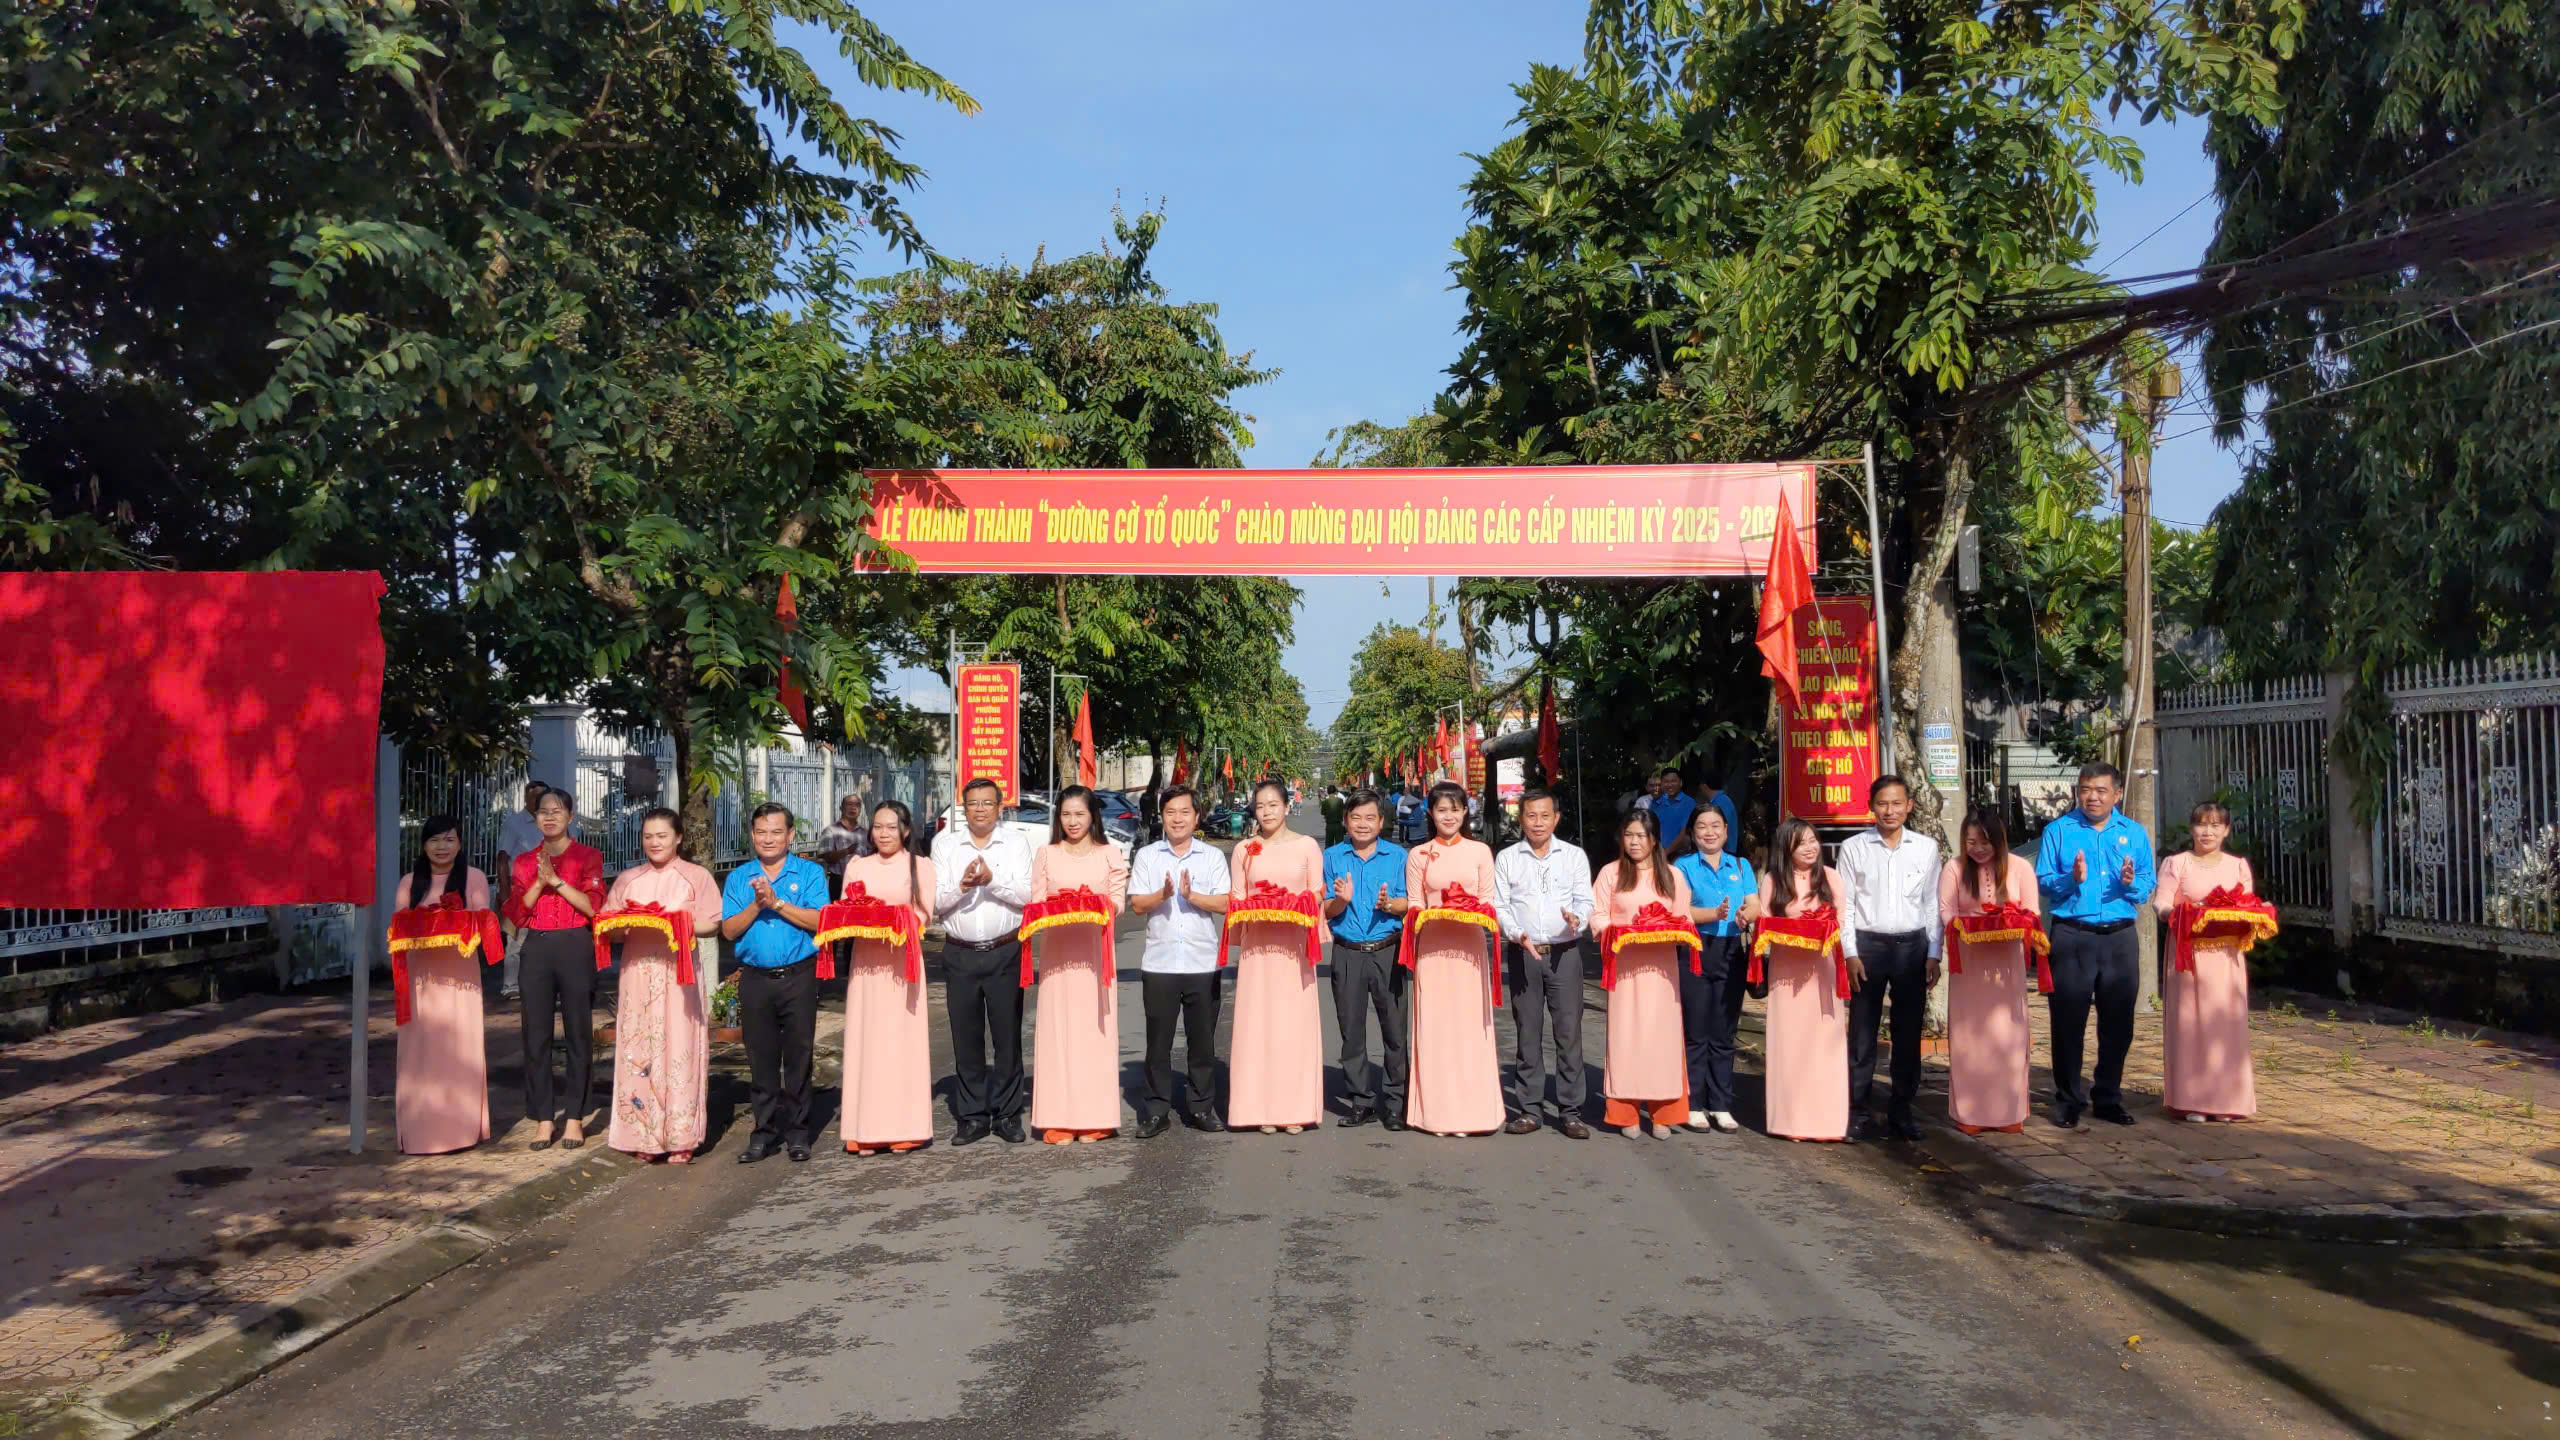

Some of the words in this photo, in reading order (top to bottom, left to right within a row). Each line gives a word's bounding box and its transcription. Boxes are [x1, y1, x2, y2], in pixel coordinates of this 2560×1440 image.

[907, 500, 969, 543] KHÁNH
[973, 501, 1033, 544] THÀNH
[1038, 499, 1110, 544] “ĐƯỜNG
[1113, 501, 1141, 544] CỜ
[1144, 494, 1168, 544] TỔ
[1170, 496, 1232, 548] QUỐC”
[1235, 502, 1285, 544] CHÀO
[1289, 503, 1346, 544] MỪNG
[1351, 508, 1383, 552] ĐẠI
[1387, 502, 1420, 552] HỘI
[1424, 496, 1478, 544] ĐẢNG
[1483, 501, 1521, 544] CÁC
[1527, 494, 1566, 544] CẤP
[1571, 504, 1635, 551] NHIỆM
[1640, 499, 1666, 543] KỲ
[1671, 506, 1721, 543] 2025
[1740, 505, 1778, 542] 203
[1799, 675, 1821, 692] LAO
[1811, 703, 1837, 723] HỌC
[1791, 731, 1822, 748] THEO
[1807, 754, 1833, 775] BÁC
[1836, 752, 1853, 775] HỒ
